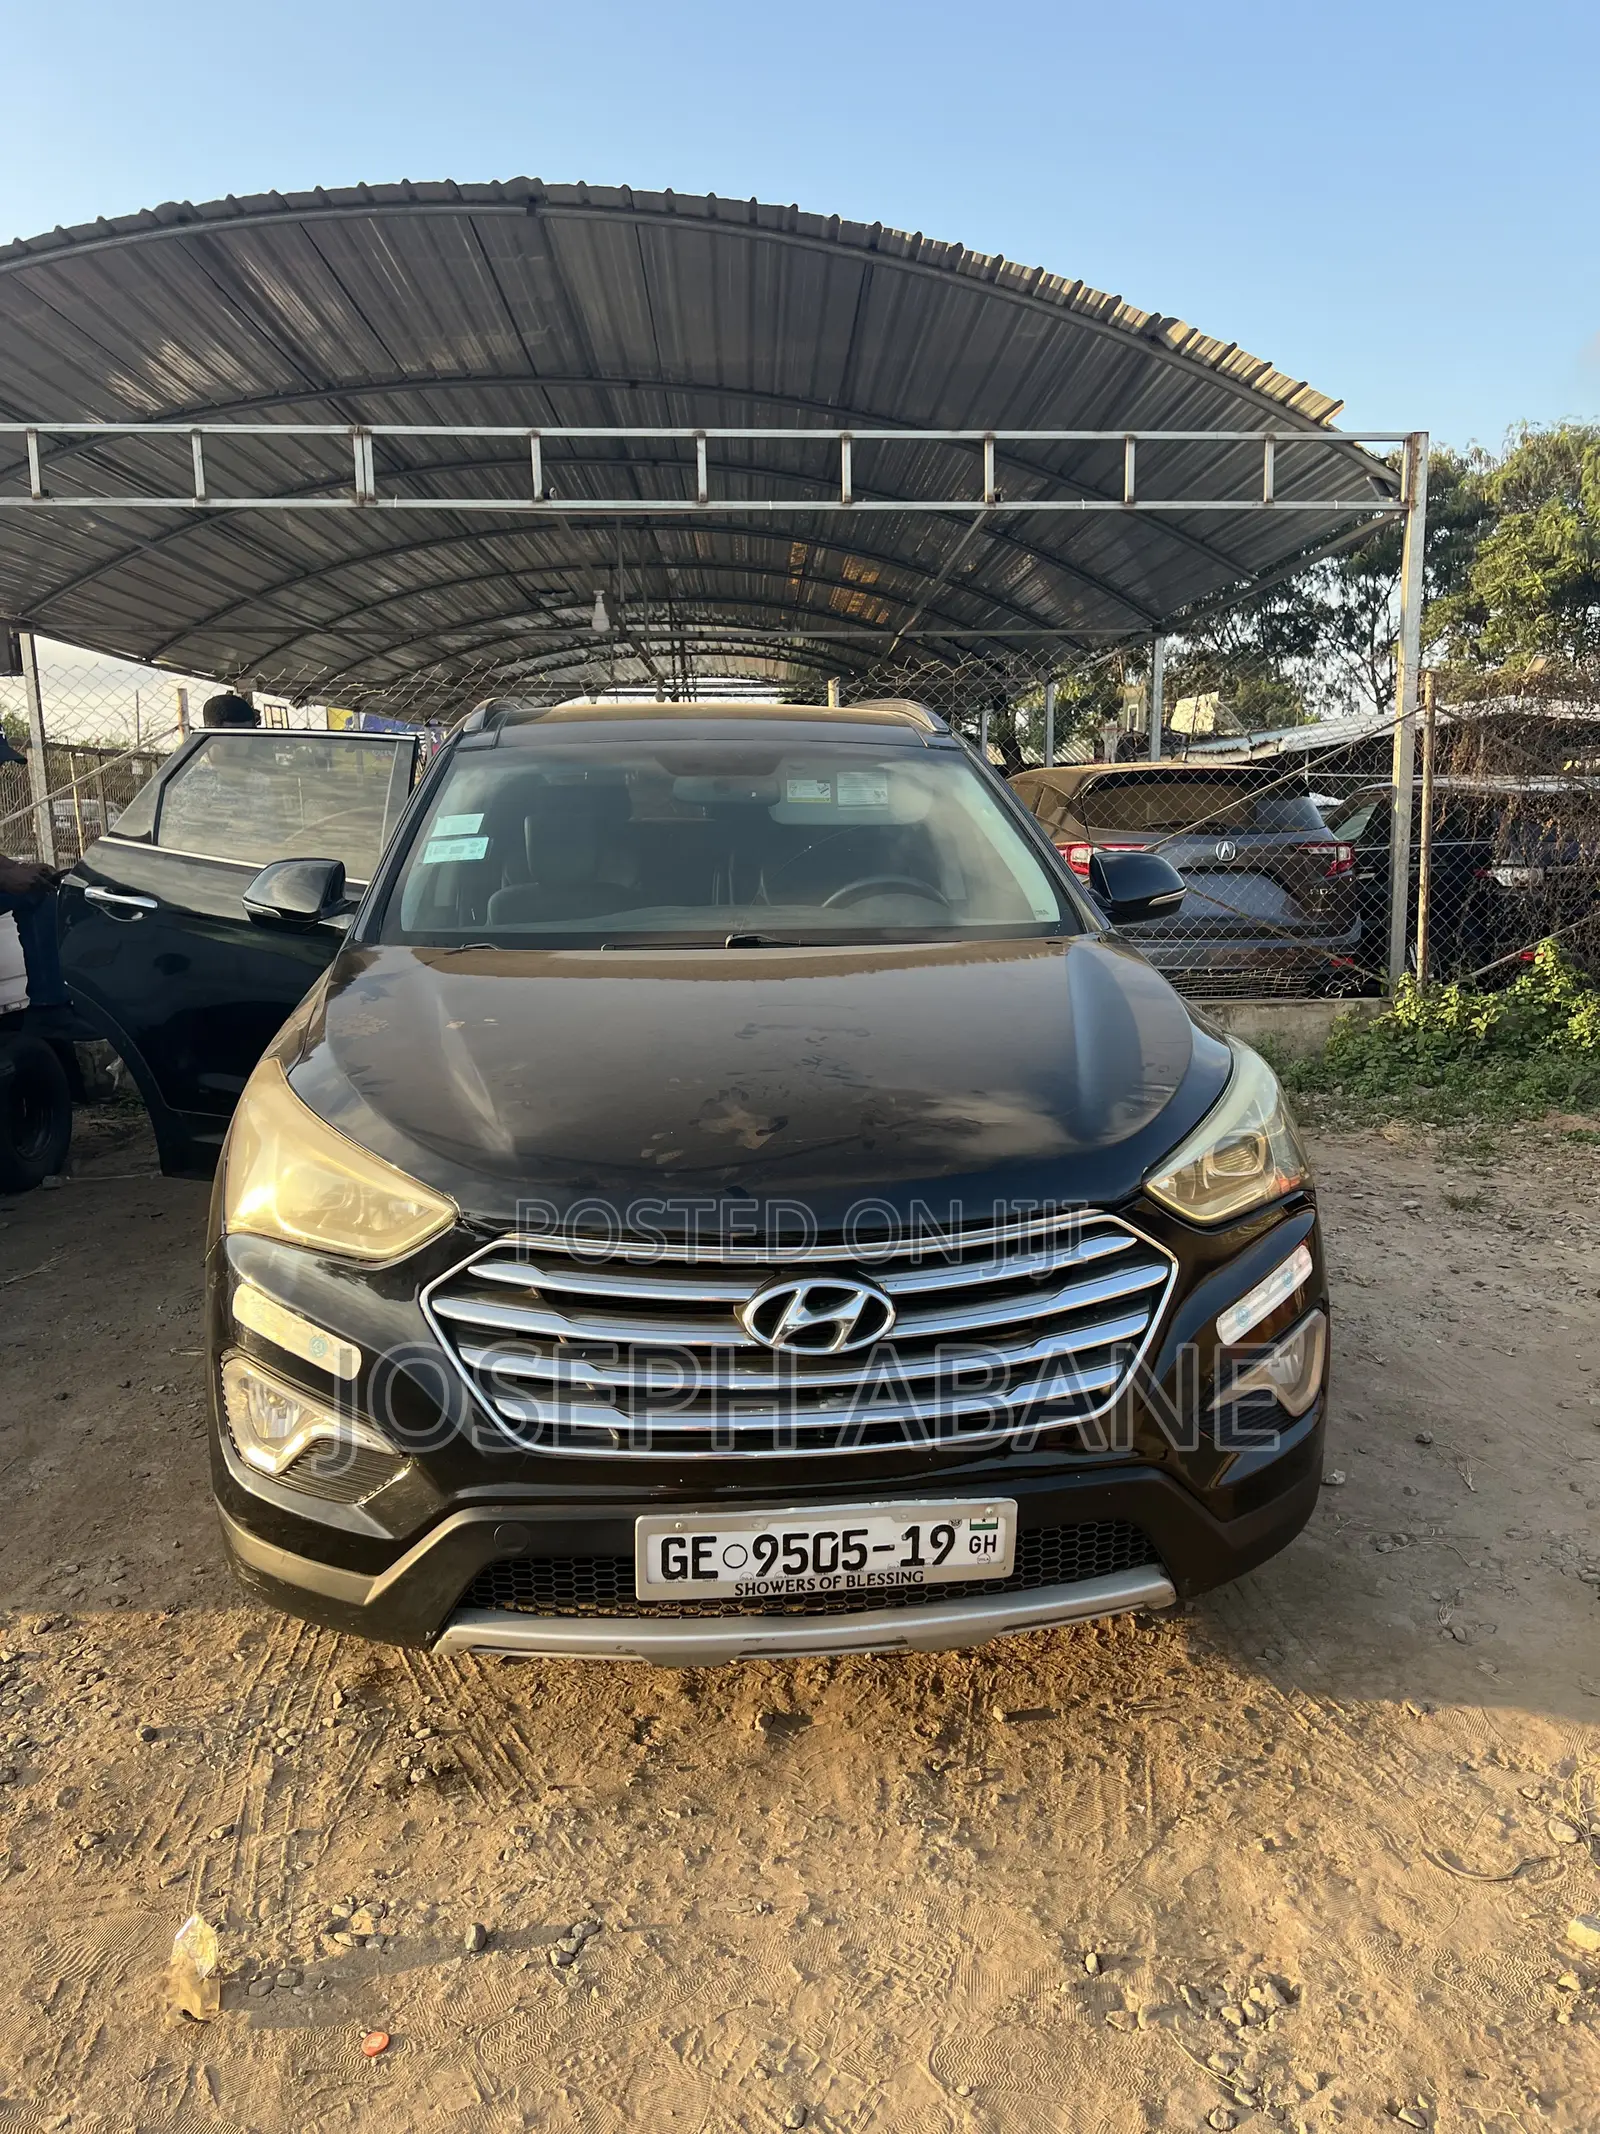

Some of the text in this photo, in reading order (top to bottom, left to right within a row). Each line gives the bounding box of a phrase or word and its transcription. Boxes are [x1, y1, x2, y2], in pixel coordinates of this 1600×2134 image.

[661, 1524, 956, 1580] GE 9505-19
[969, 1533, 997, 1554] GH
[735, 1570, 925, 1597] SHOWERS OF BLESSING
